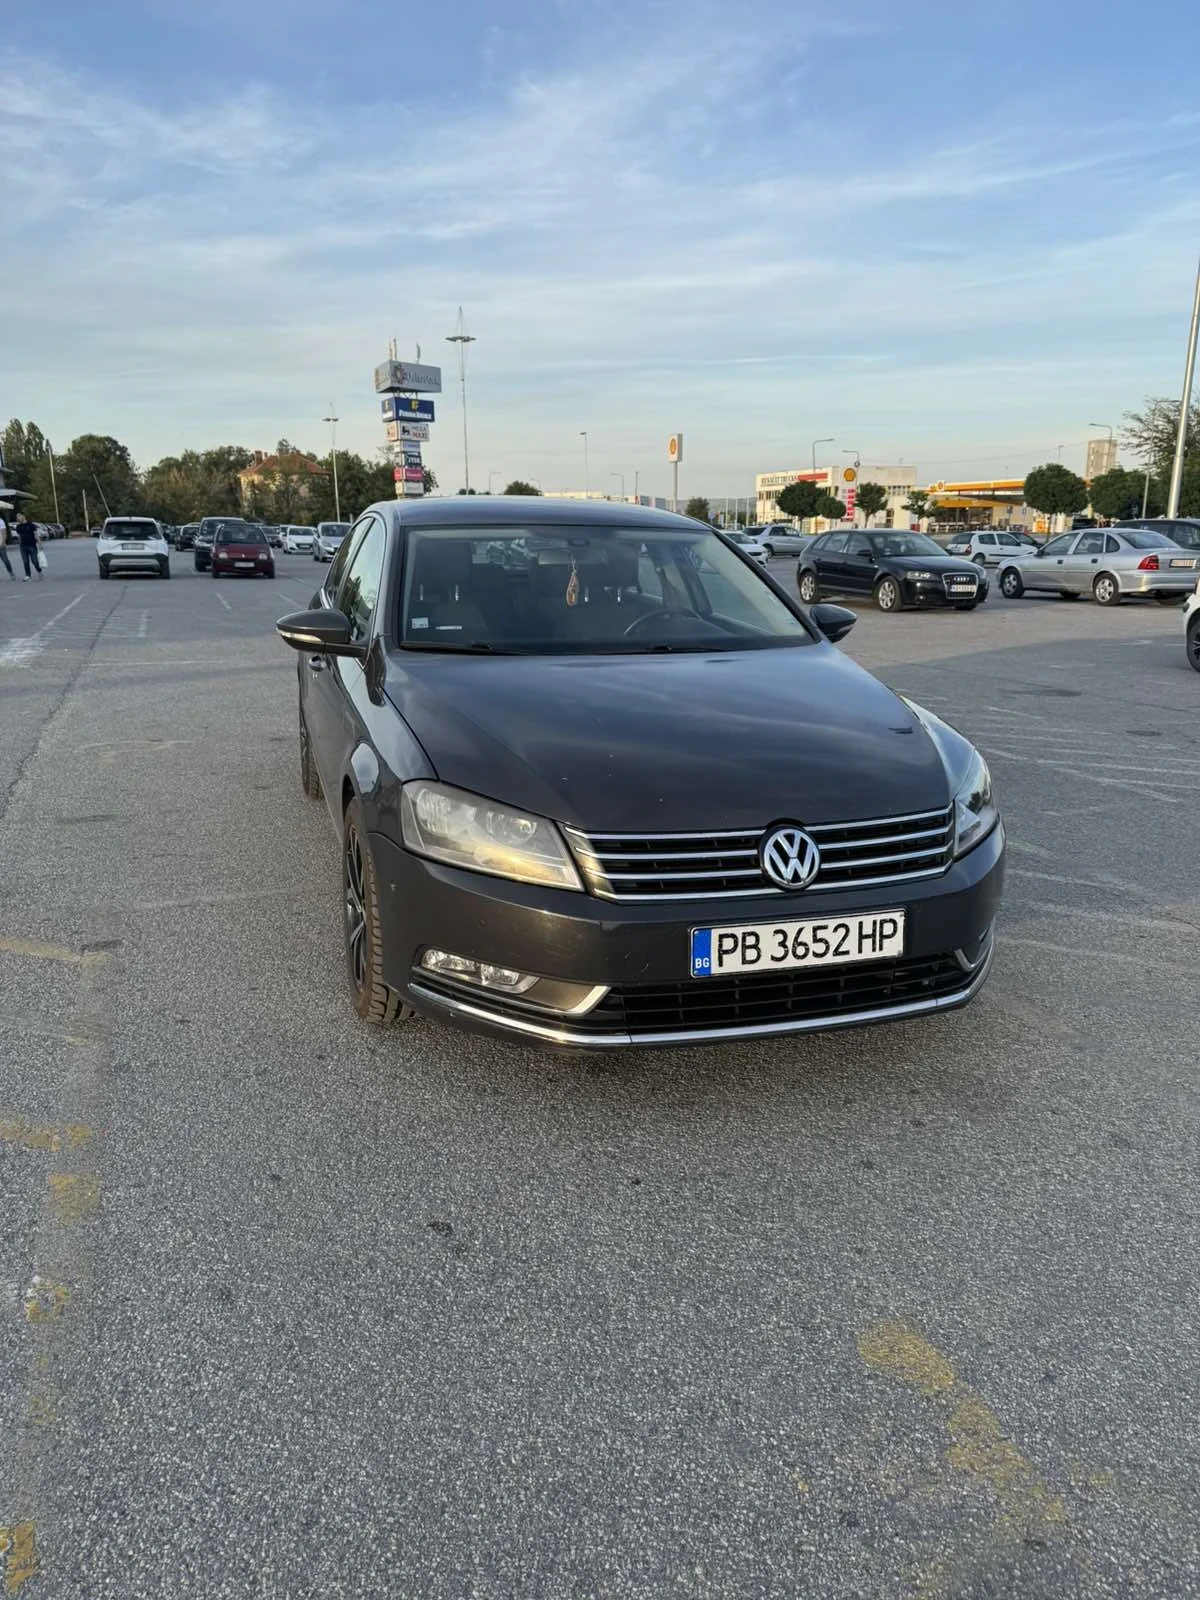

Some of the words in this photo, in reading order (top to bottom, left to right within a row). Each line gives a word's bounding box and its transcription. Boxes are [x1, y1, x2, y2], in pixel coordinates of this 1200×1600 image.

[717, 931, 762, 967] PB
[770, 922, 850, 963] 3652
[857, 917, 898, 954] HP
[695, 958, 710, 968] BG
